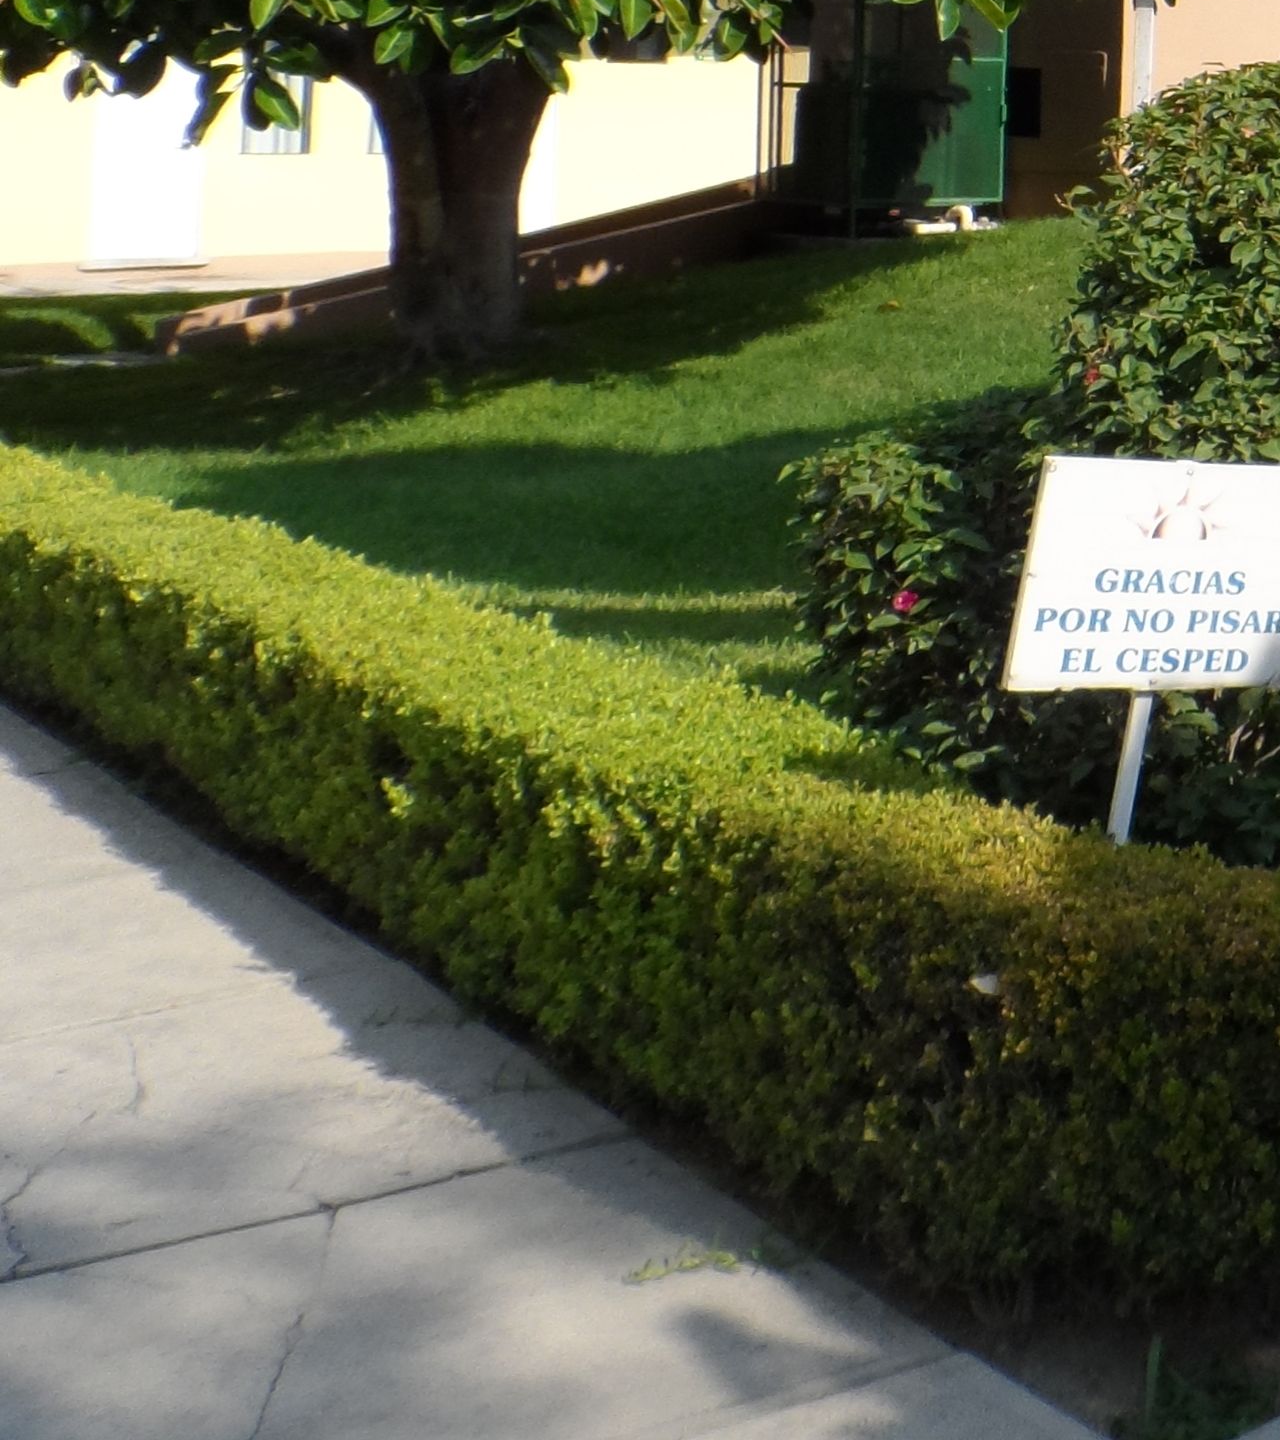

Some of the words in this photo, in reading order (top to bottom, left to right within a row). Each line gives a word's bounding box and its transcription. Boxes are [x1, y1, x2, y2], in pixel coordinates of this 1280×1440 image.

[1095, 568, 1246, 595] GRACIAS
[1034, 608, 1112, 634] POR
[1122, 609, 1175, 634] NO
[1060, 648, 1101, 673] EL
[1115, 648, 1249, 673] CESPED
